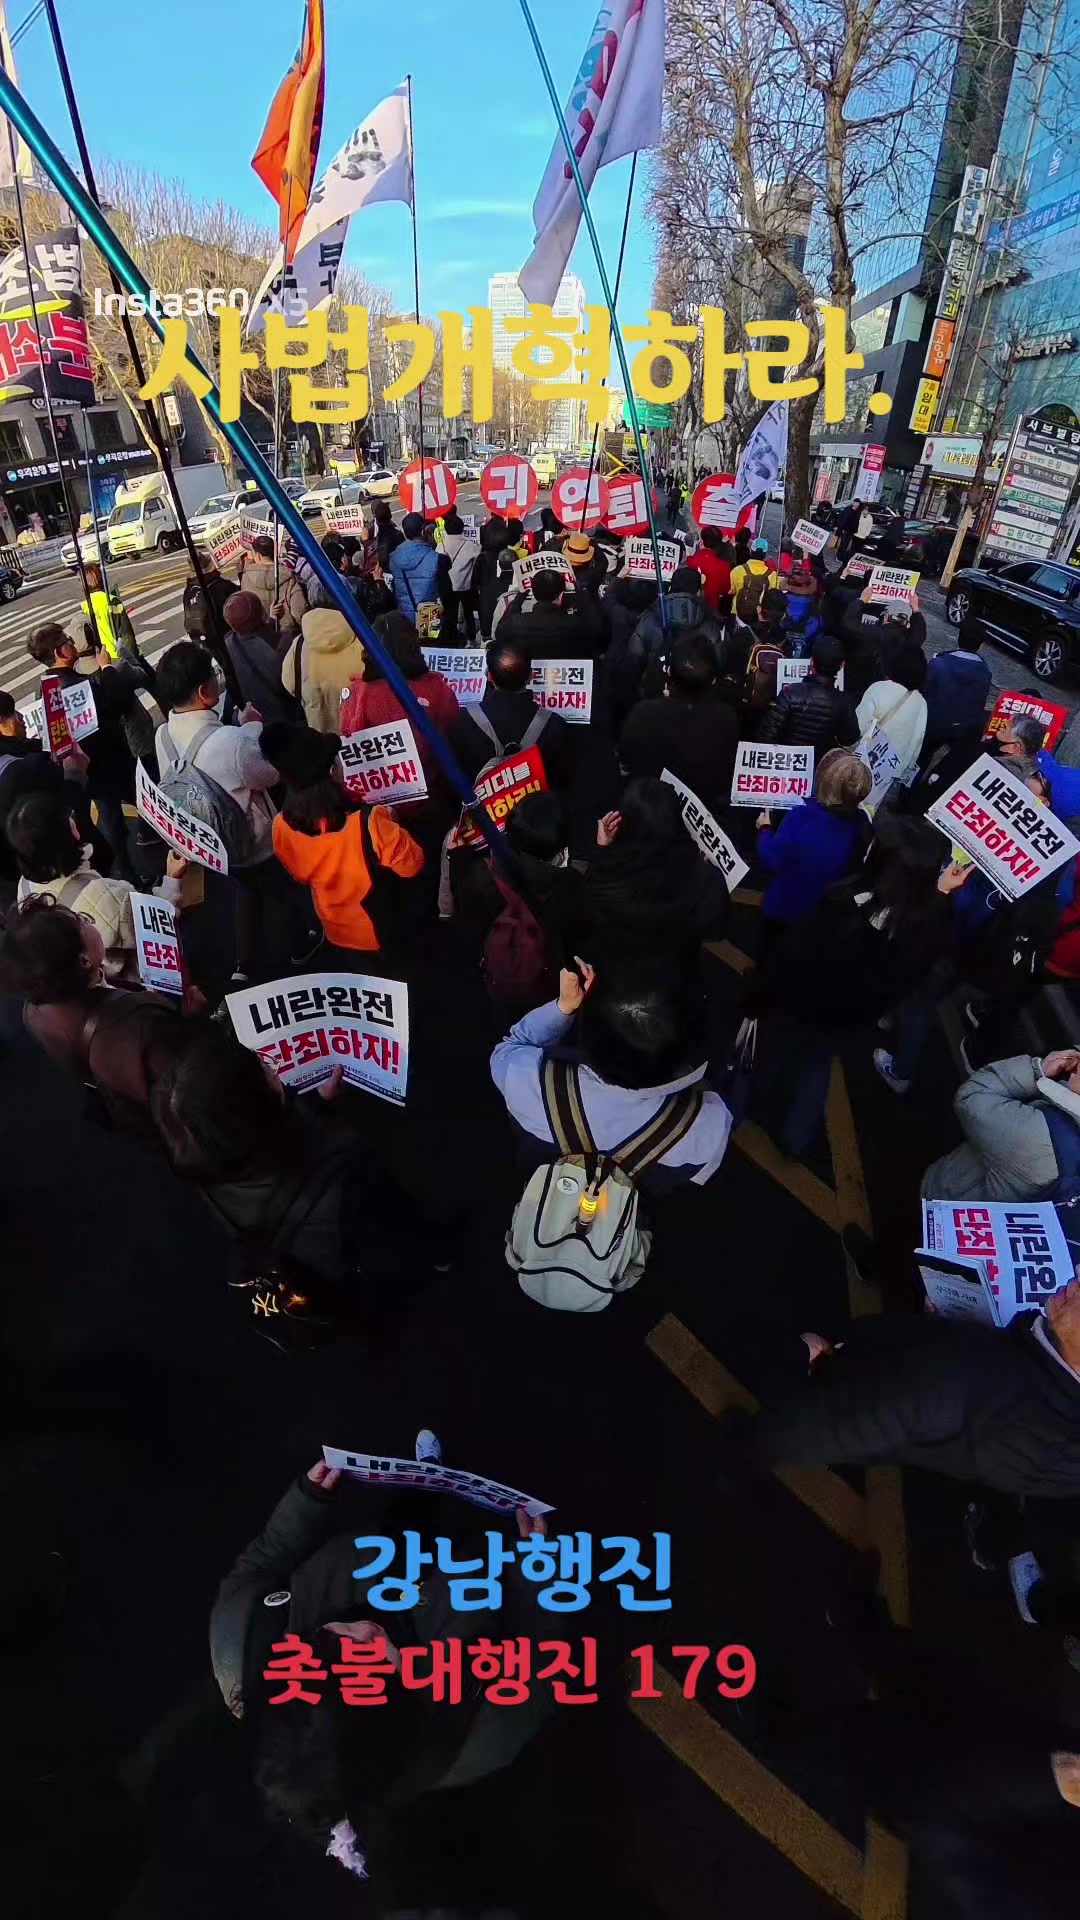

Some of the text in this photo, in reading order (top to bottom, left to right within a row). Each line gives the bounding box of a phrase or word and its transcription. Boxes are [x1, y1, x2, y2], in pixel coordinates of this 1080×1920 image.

[405, 465, 449, 512] 지
[487, 463, 529, 508] 귀
[559, 473, 601, 522] 연
[607, 481, 648, 529] 퇴
[519, 555, 570, 574] 내란완전
[630, 542, 676, 559] 내란완전
[443, 677, 483, 694] 하자!
[531, 667, 585, 688] 란완전
[341, 731, 407, 769] 란완전
[741, 749, 809, 773] 내란완전
[344, 761, 418, 795] 죄하자!
[736, 774, 809, 796] 단죄하자!
[141, 775, 220, 853] 내란완전
[141, 793, 223, 872] 단죄하자!
[970, 768, 1066, 860] 내란완전
[944, 790, 1042, 885] 단죄하자!
[248, 986, 395, 1035] 내란완전
[255, 1026, 400, 1076] 단죄하자!
